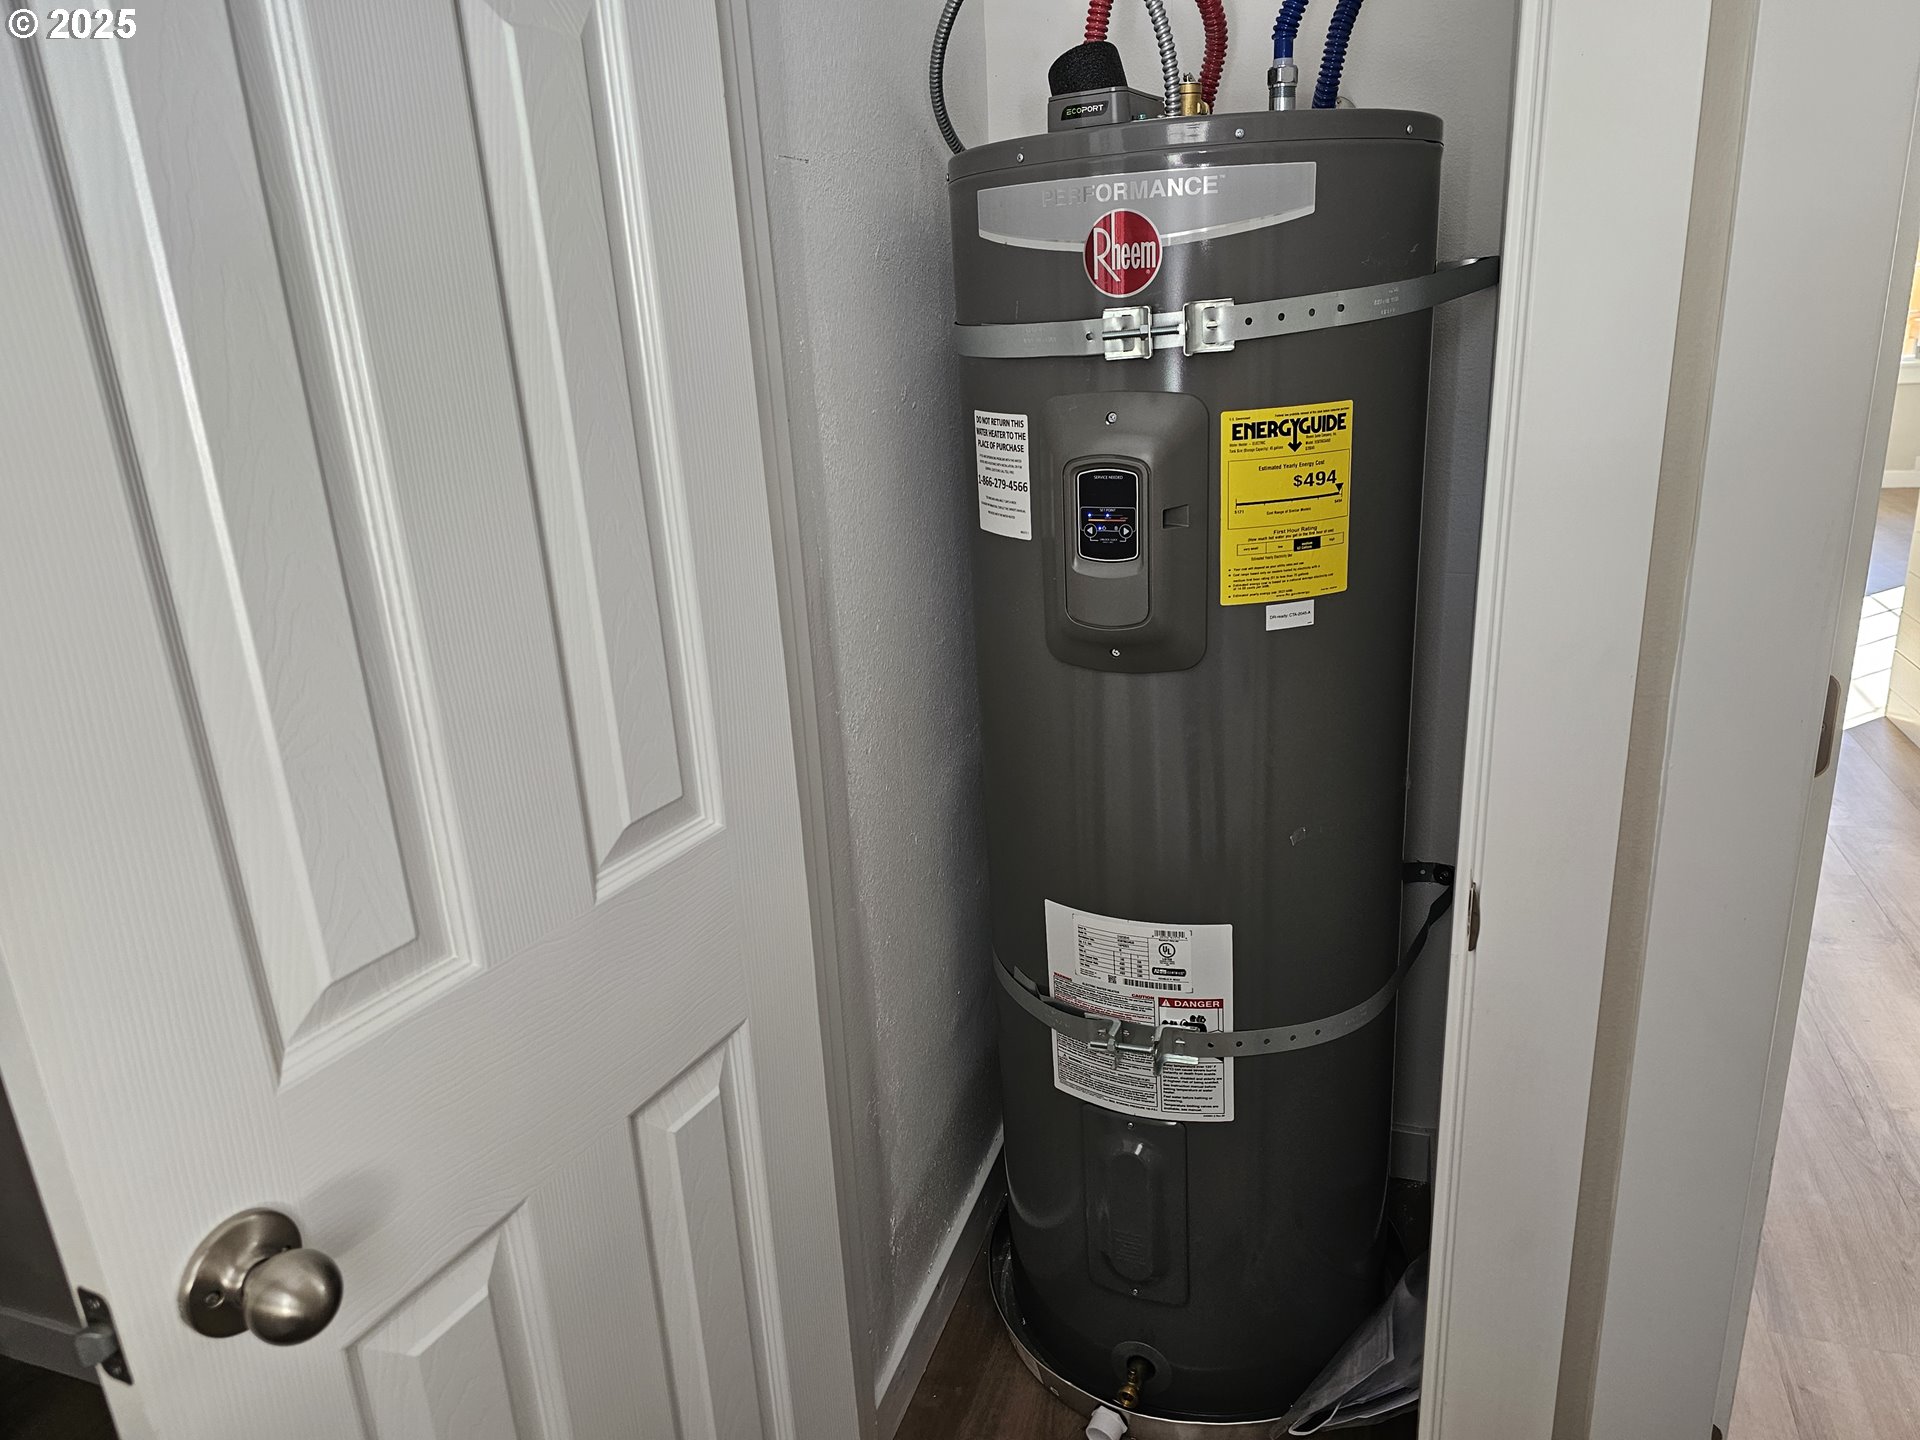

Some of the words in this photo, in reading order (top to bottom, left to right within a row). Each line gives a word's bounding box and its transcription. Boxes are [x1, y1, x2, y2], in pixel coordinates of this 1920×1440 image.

[1066, 104, 1104, 116] ECOPORT
[1092, 210, 1157, 282] Rheem
[982, 416, 990, 425] NOT
[991, 417, 1010, 427] RETURN
[1011, 419, 1024, 428] THIS
[988, 429, 1006, 439] HEATER
[1006, 431, 1014, 440] TO
[1014, 432, 1026, 440] THE
[1232, 412, 1347, 452] ENERGYGUIDE
[977, 439, 989, 449] PLACE
[990, 441, 996, 450] OF
[996, 442, 1024, 453] PURCHASE
[978, 474, 1028, 492] 1-866-279-4566
[1293, 469, 1337, 488] $494
[1162, 945, 1172, 956] UL
